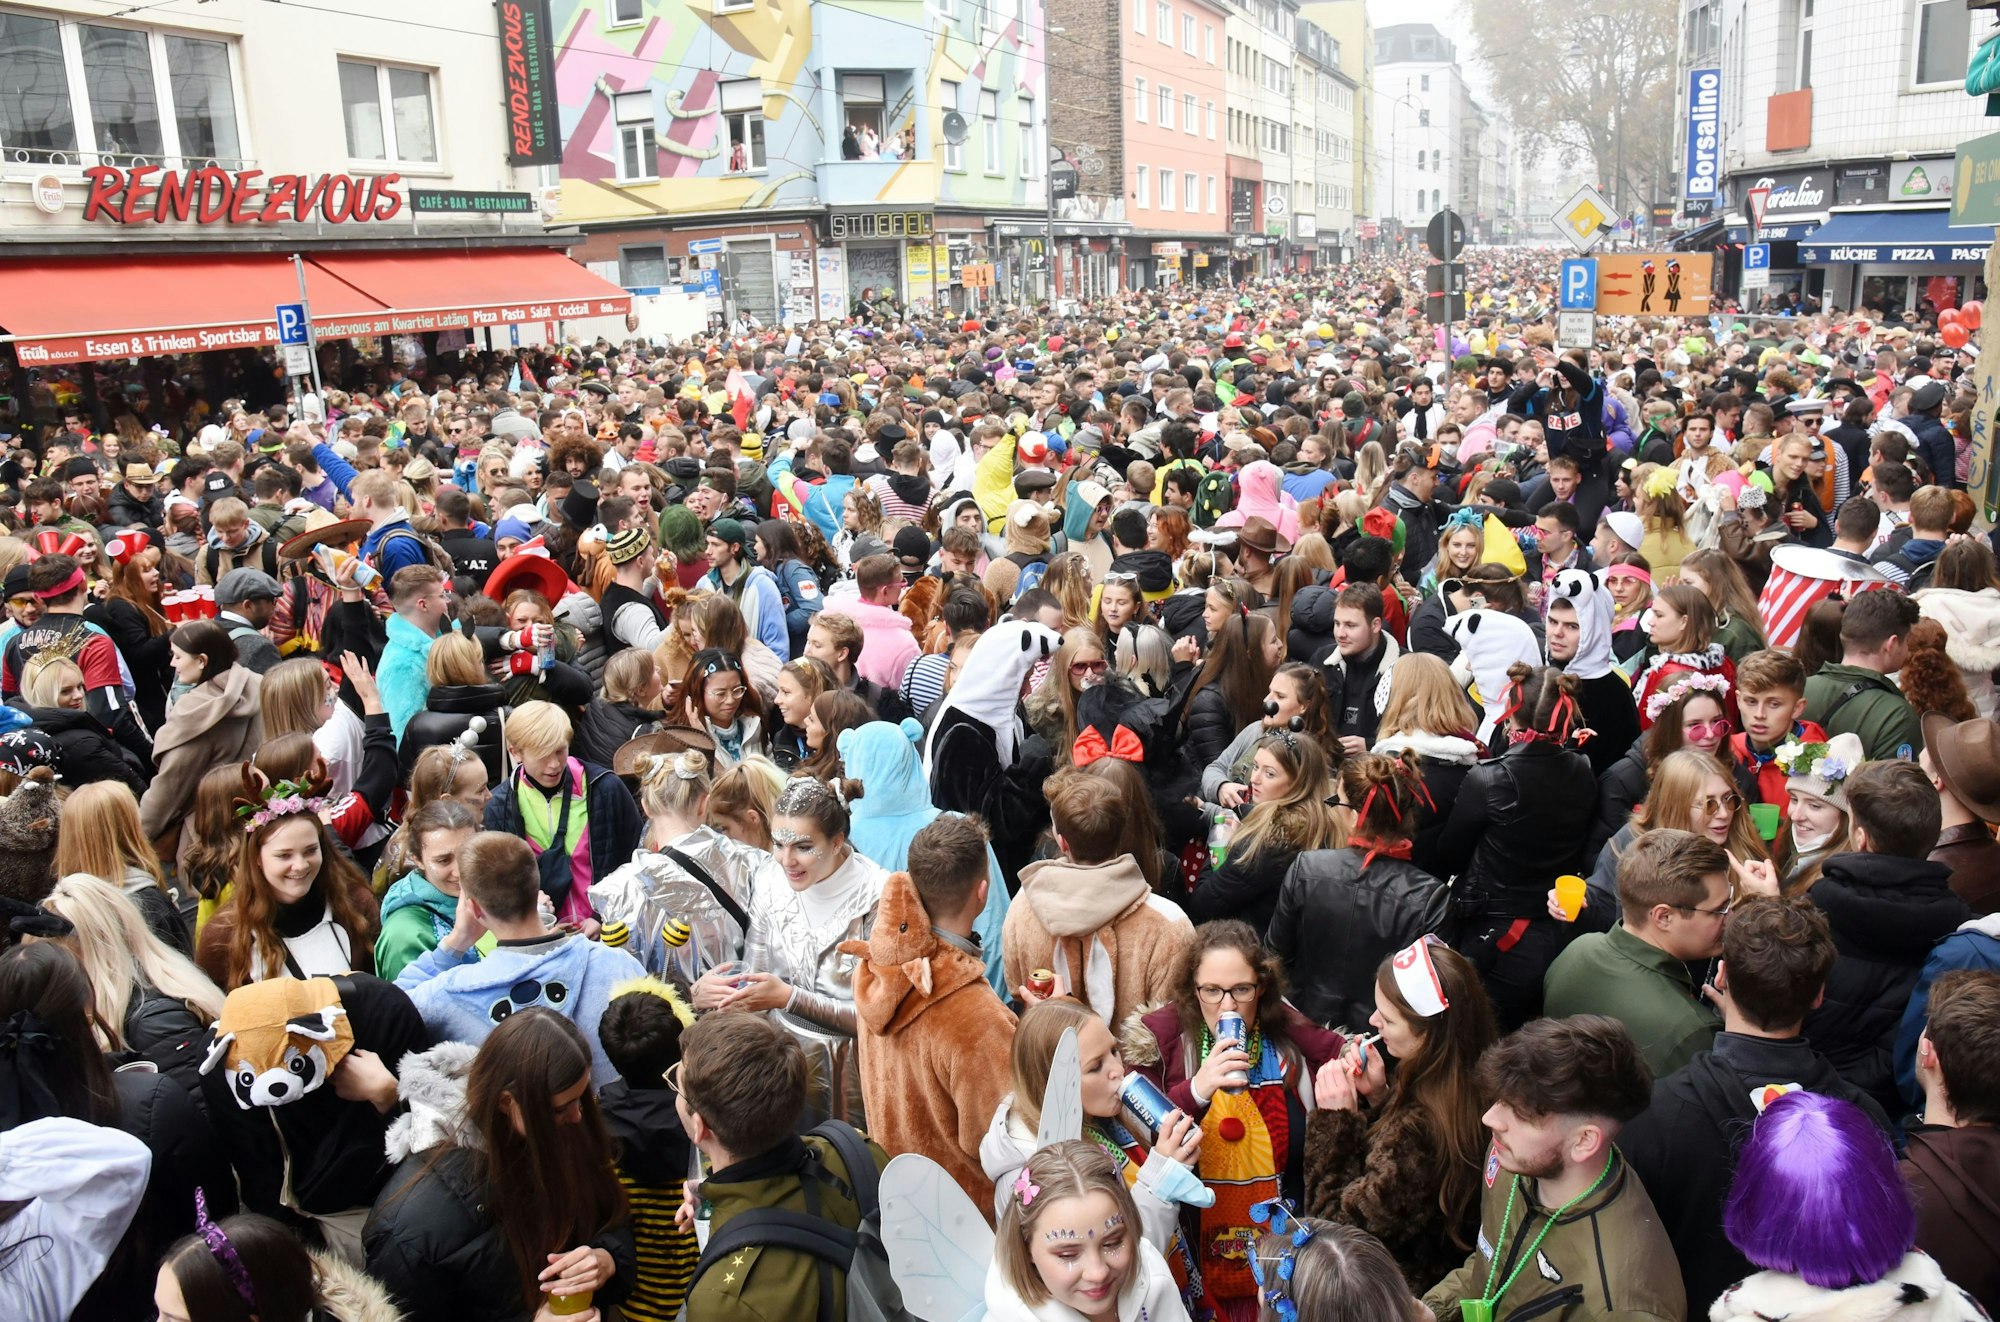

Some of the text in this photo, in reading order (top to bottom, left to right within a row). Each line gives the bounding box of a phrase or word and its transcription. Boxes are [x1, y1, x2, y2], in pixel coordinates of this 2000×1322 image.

[503, 2, 532, 156] RENDEZVOUS
[525, 12, 545, 147] CAFÉ BAR RESTAURANT
[1689, 73, 1718, 194] Borsalino
[83, 164, 402, 224] RENDEZVOUS
[419, 194, 527, 210] CAFÉ BAR RESTAURANT
[1686, 200, 1708, 213] sky
[832, 213, 934, 239] STIEFEL
[1267, 236, 1279, 246] sky
[1749, 247, 1764, 267] P
[1830, 246, 1989, 260] KÜCHE PIZZA PAST
[1568, 265, 1588, 303] P
[19, 345, 48, 360] früh
[51, 351, 79, 359] KÖLSCH
[85, 341, 128, 356] Essen
[131, 338, 144, 353] &
[145, 334, 196, 351] Trinken
[200, 328, 261, 348] Sportsbar
[313, 322, 371, 337] endezvous
[374, 321, 389, 332] am
[392, 314, 433, 330] Kwartier
[437, 313, 468, 327] Latäng
[473, 310, 497, 323] Pizza
[502, 308, 525, 321] Pasta
[531, 306, 551, 319] Salat
[558, 303, 589, 316] Cocktail
[280, 309, 298, 340] P
[1125, 1092, 1156, 1126] ENERGY
